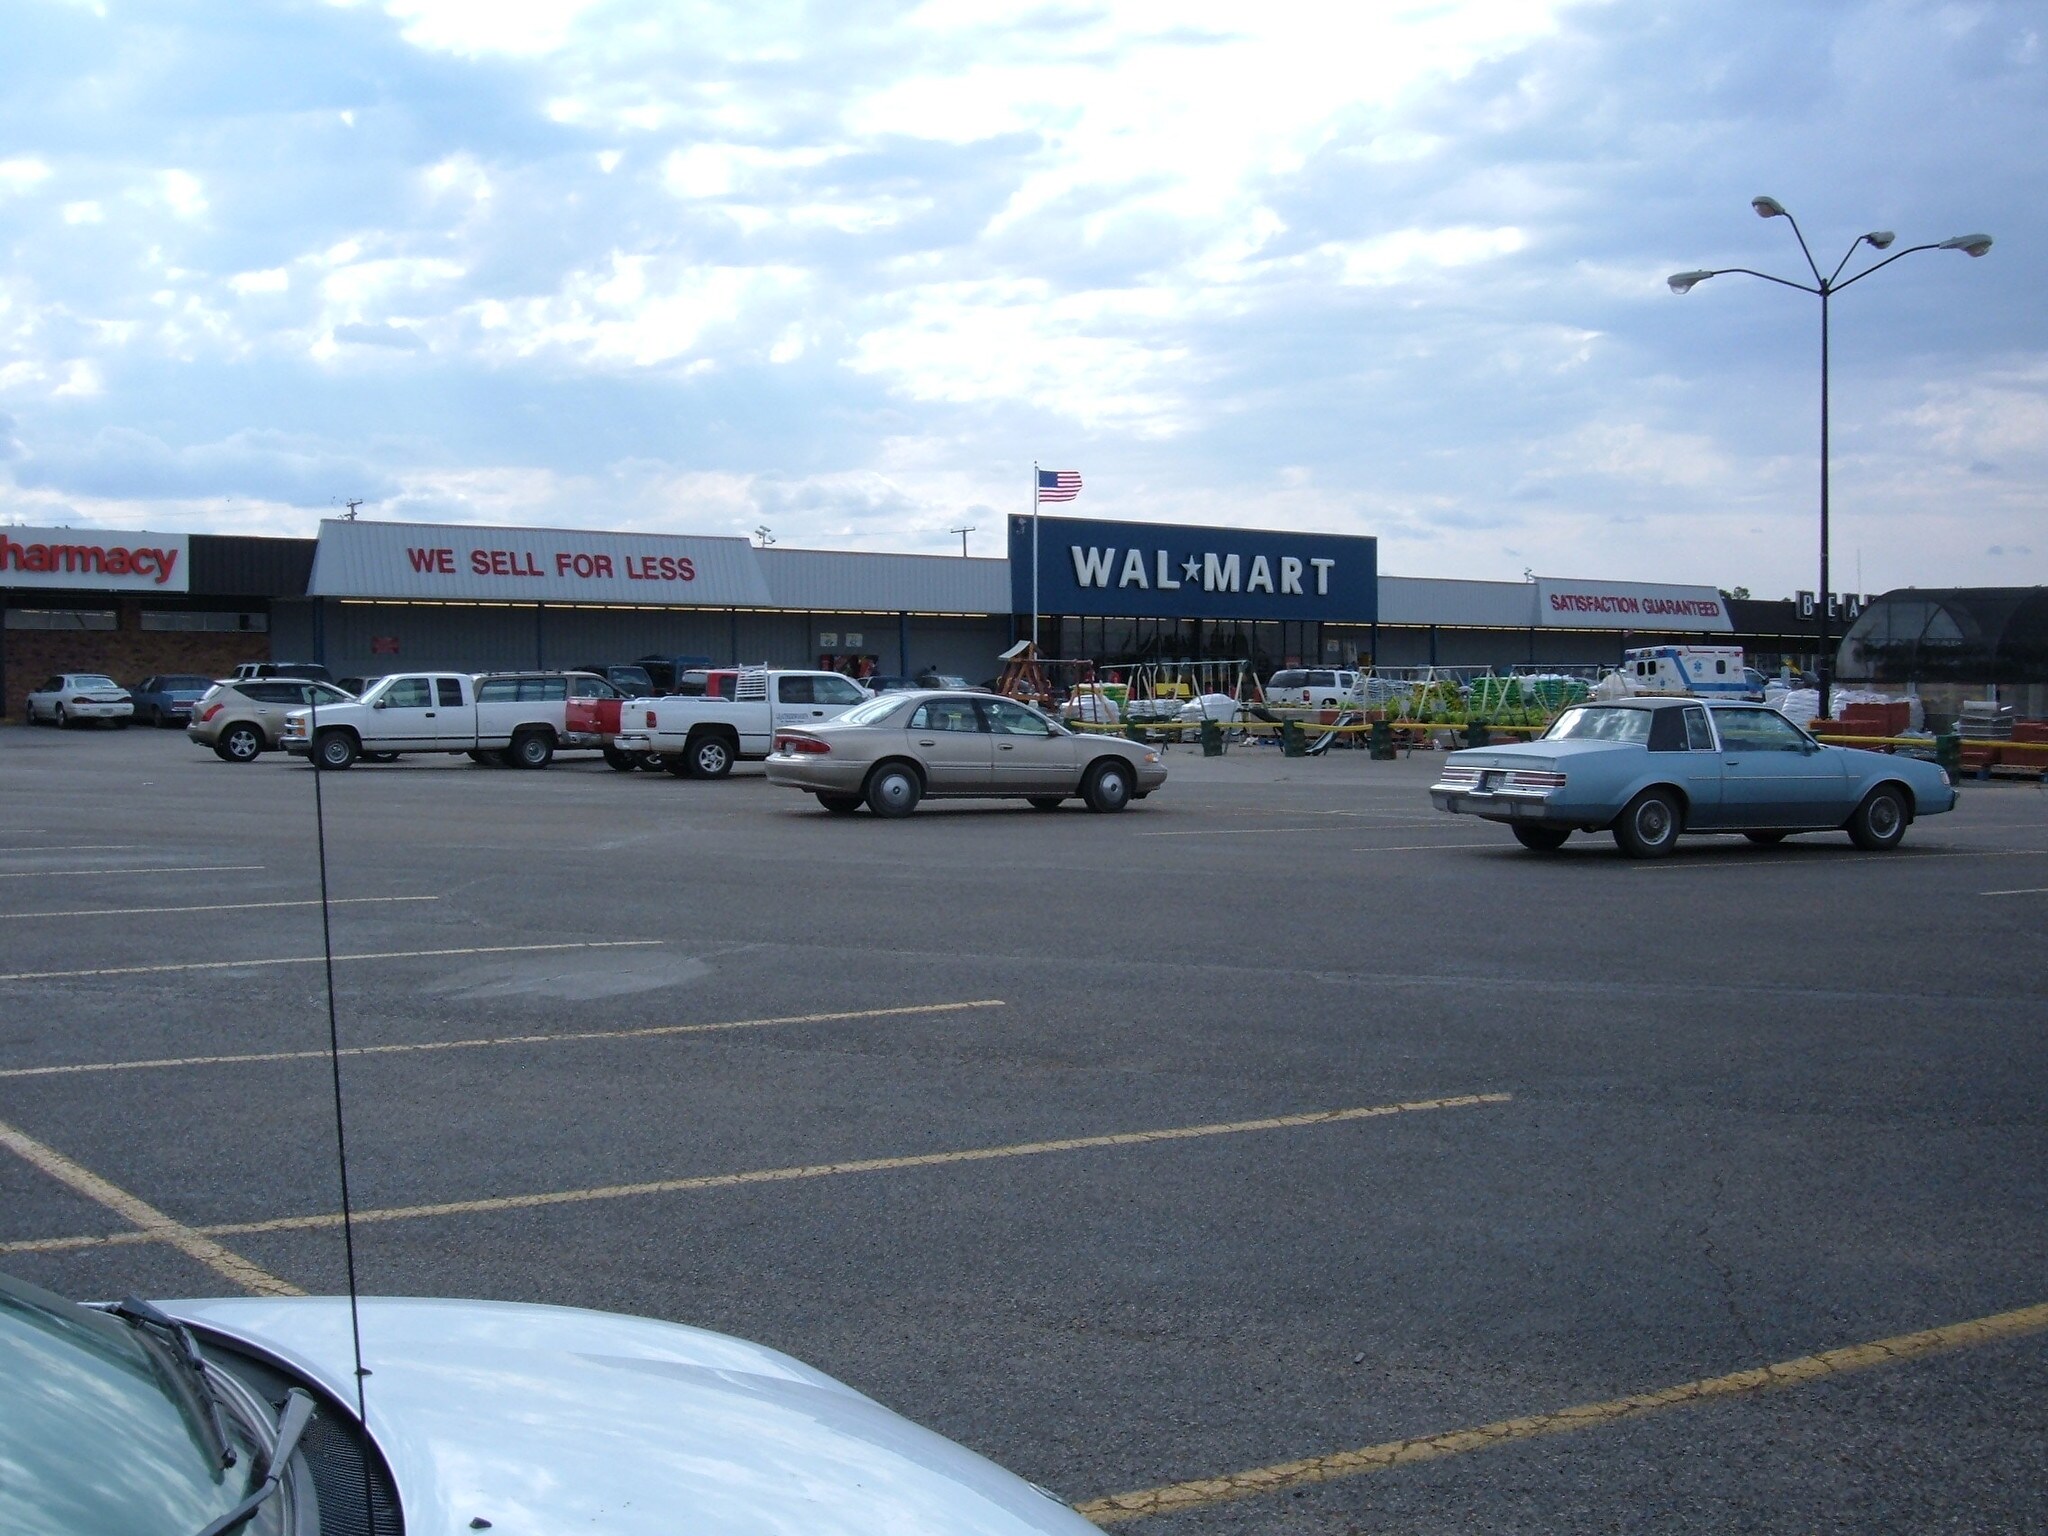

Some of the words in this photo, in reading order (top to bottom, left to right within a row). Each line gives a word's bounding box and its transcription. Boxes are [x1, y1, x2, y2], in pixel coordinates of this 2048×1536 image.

[408, 547, 456, 574] WE
[471, 549, 544, 577] SELL
[556, 553, 614, 579] FOR
[626, 556, 696, 582] LESS
[1550, 593, 1640, 614] SATISFACTION
[1642, 597, 1720, 618] GUARANTEED
[1803, 594, 1876, 618] BEA
